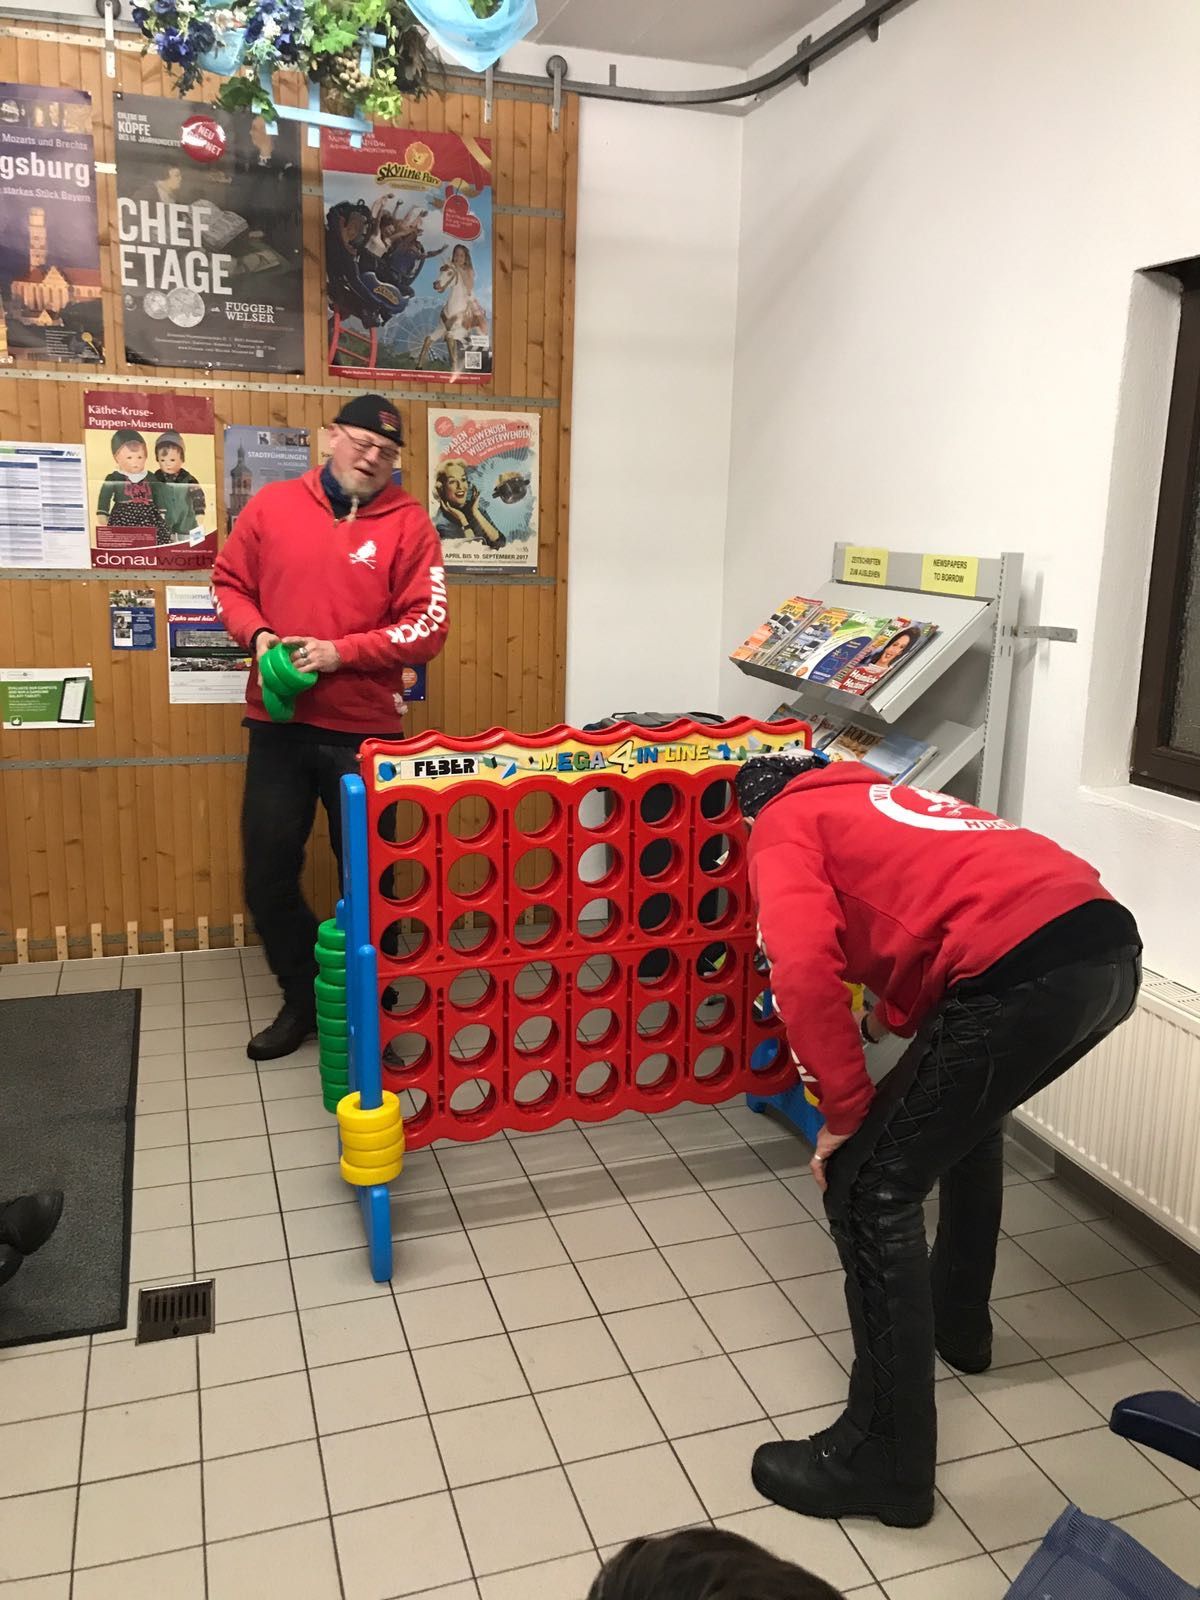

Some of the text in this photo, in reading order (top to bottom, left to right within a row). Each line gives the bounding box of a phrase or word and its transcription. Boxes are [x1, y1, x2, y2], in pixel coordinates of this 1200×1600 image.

[118, 121, 151, 136] KÖPFE
[197, 124, 216, 141] NEU
[1, 132, 88, 151] Mozarts und Brechts
[0, 151, 90, 188] gsburg
[61, 190, 91, 202] Bayern
[117, 197, 212, 248] CHEF
[119, 243, 233, 296] ETAGE
[225, 301, 275, 314] FUGGER
[225, 311, 275, 324] WELSER
[88, 405, 154, 417] Käthe-Kruse-
[88, 416, 173, 430] Puppen-Museum
[453, 423, 507, 455] VERSCHWENDEN
[466, 429, 537, 457] WIEDERVERWENDEN
[247, 451, 308, 461] STADTFÜHRUNGEN
[851, 556, 881, 566] ZEITSCHRIFTEN
[933, 559, 968, 569] NEWSPAPERS
[849, 568, 858, 576] ZUM
[934, 572, 965, 583] TO BORROW
[540, 739, 711, 774] MEGA 4 IN LINE
[413, 758, 475, 777] FEBER
